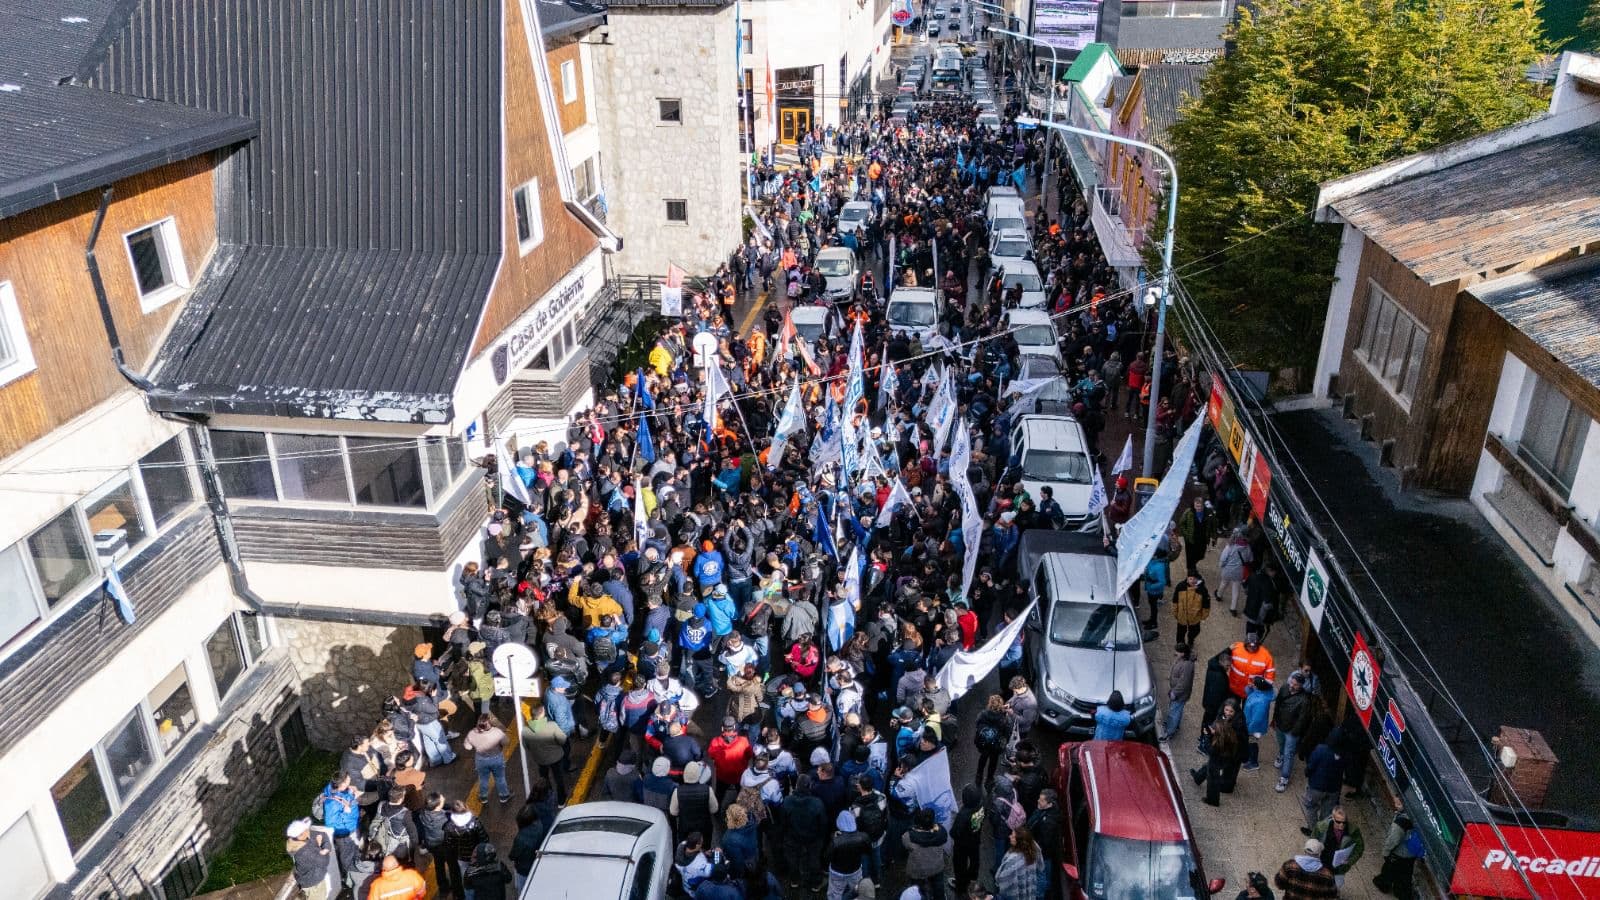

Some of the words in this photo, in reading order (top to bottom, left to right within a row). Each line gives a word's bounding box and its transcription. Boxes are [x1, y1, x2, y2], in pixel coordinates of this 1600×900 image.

[510, 323, 534, 357] Casa
[536, 309, 548, 332] de
[548, 275, 585, 318] Gobierno
[1268, 502, 1285, 539] Stella
[1283, 533, 1301, 573] Maris
[1377, 734, 1397, 779] FILA
